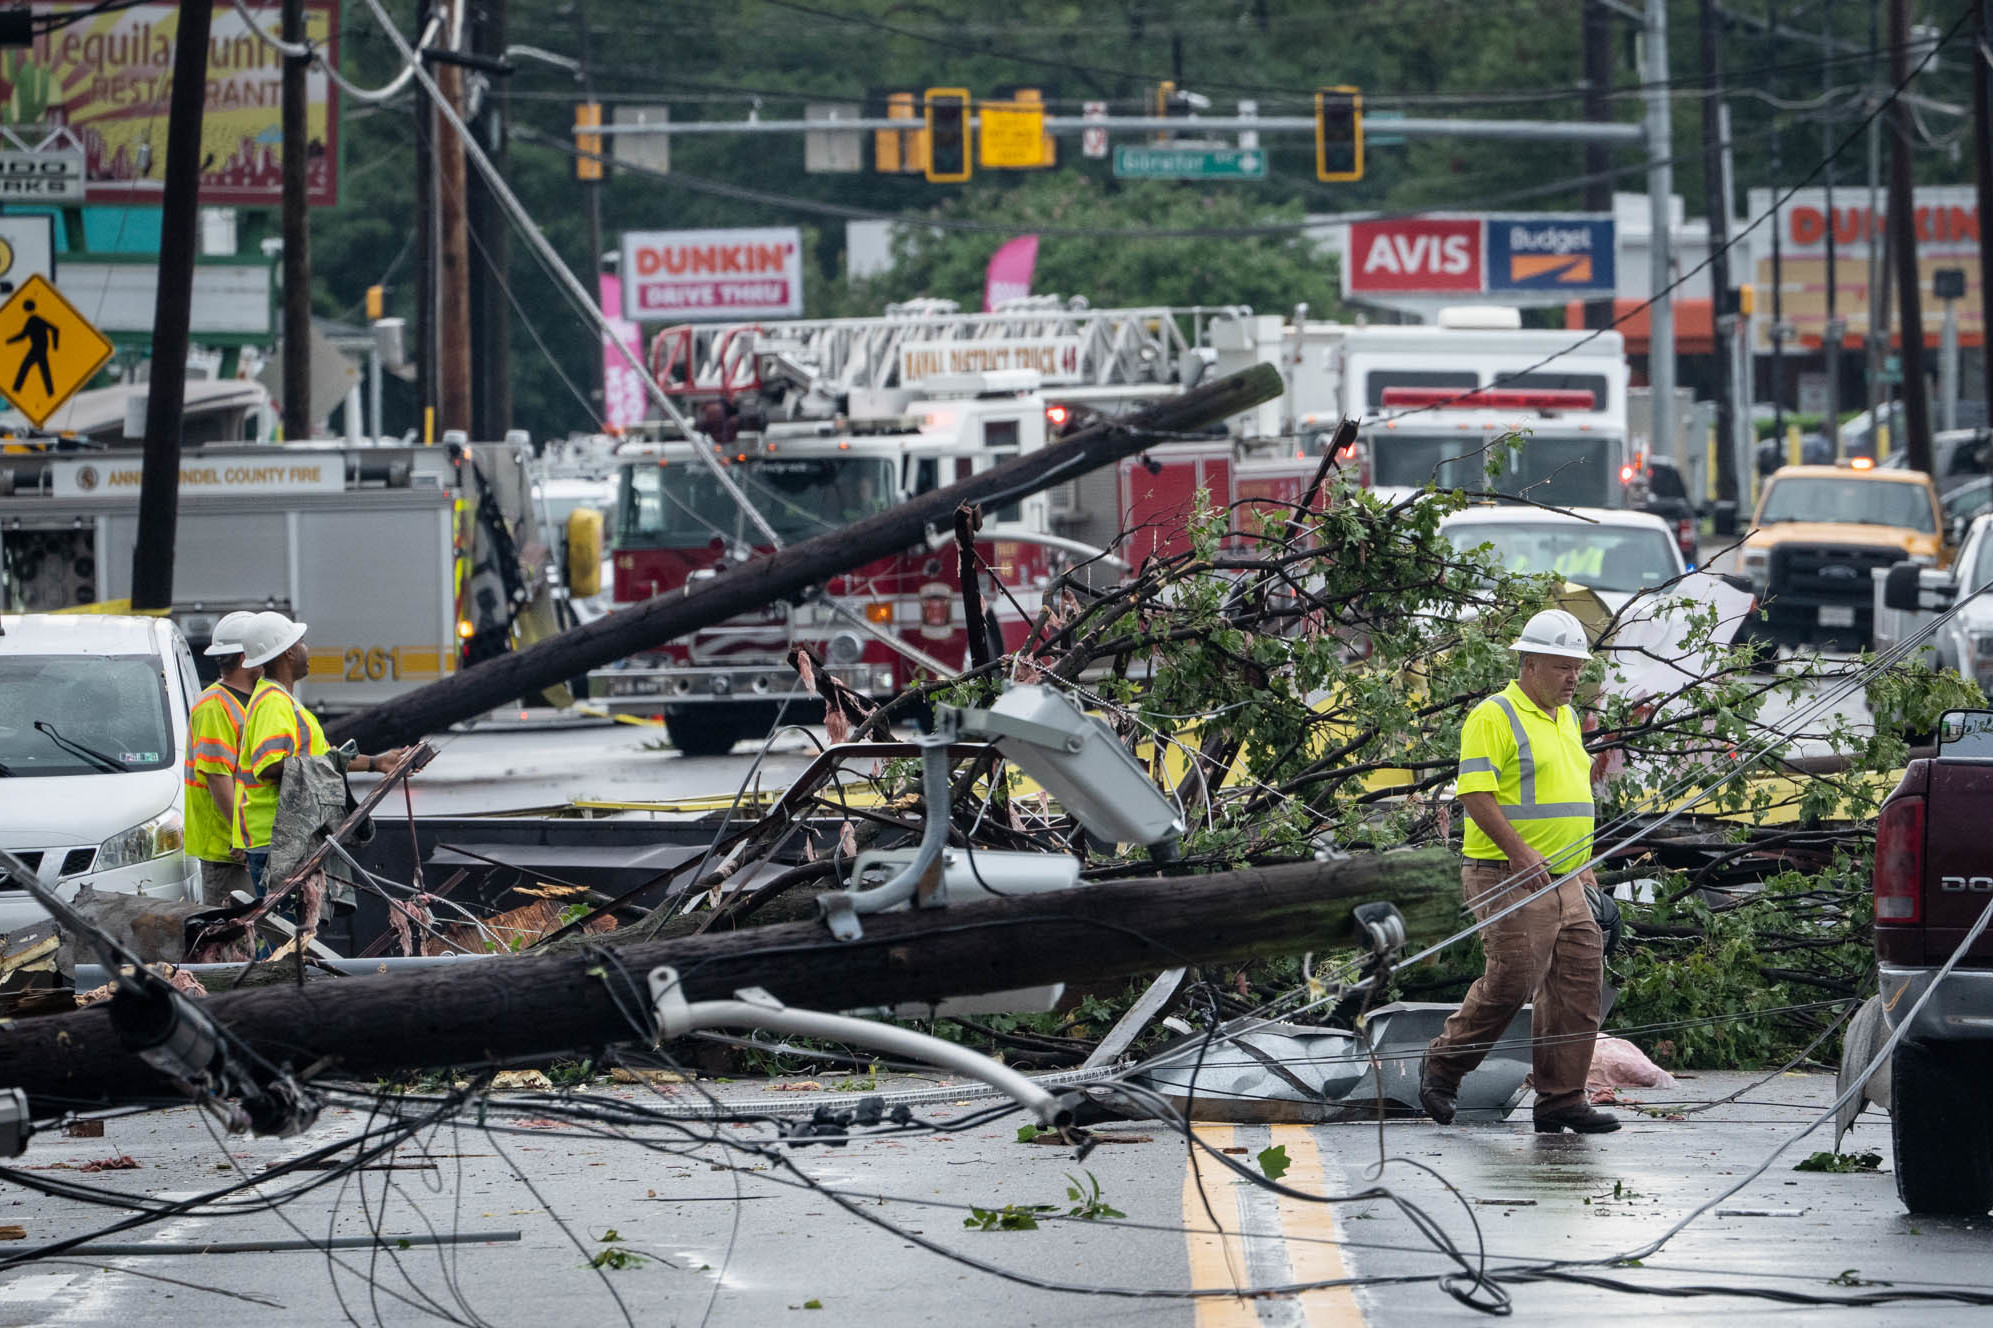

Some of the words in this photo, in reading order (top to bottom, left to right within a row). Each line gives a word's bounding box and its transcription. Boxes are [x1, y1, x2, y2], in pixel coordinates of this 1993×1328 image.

[92, 75, 281, 106] RESTARANT
[636, 243, 794, 276] DUNKIN'
[1363, 234, 1470, 274] AVIS
[1509, 226, 1591, 253] Budget
[647, 283, 714, 306] DRIVE
[720, 281, 783, 304] THRU
[905, 351, 944, 382] NAVAL
[951, 347, 1010, 374] DISTRICT
[1015, 346, 1056, 376] TRUCK
[225, 466, 285, 484] COUNTY
[289, 465, 322, 483] FIRE
[345, 647, 401, 682] 261
[1941, 876, 1993, 891] DO
